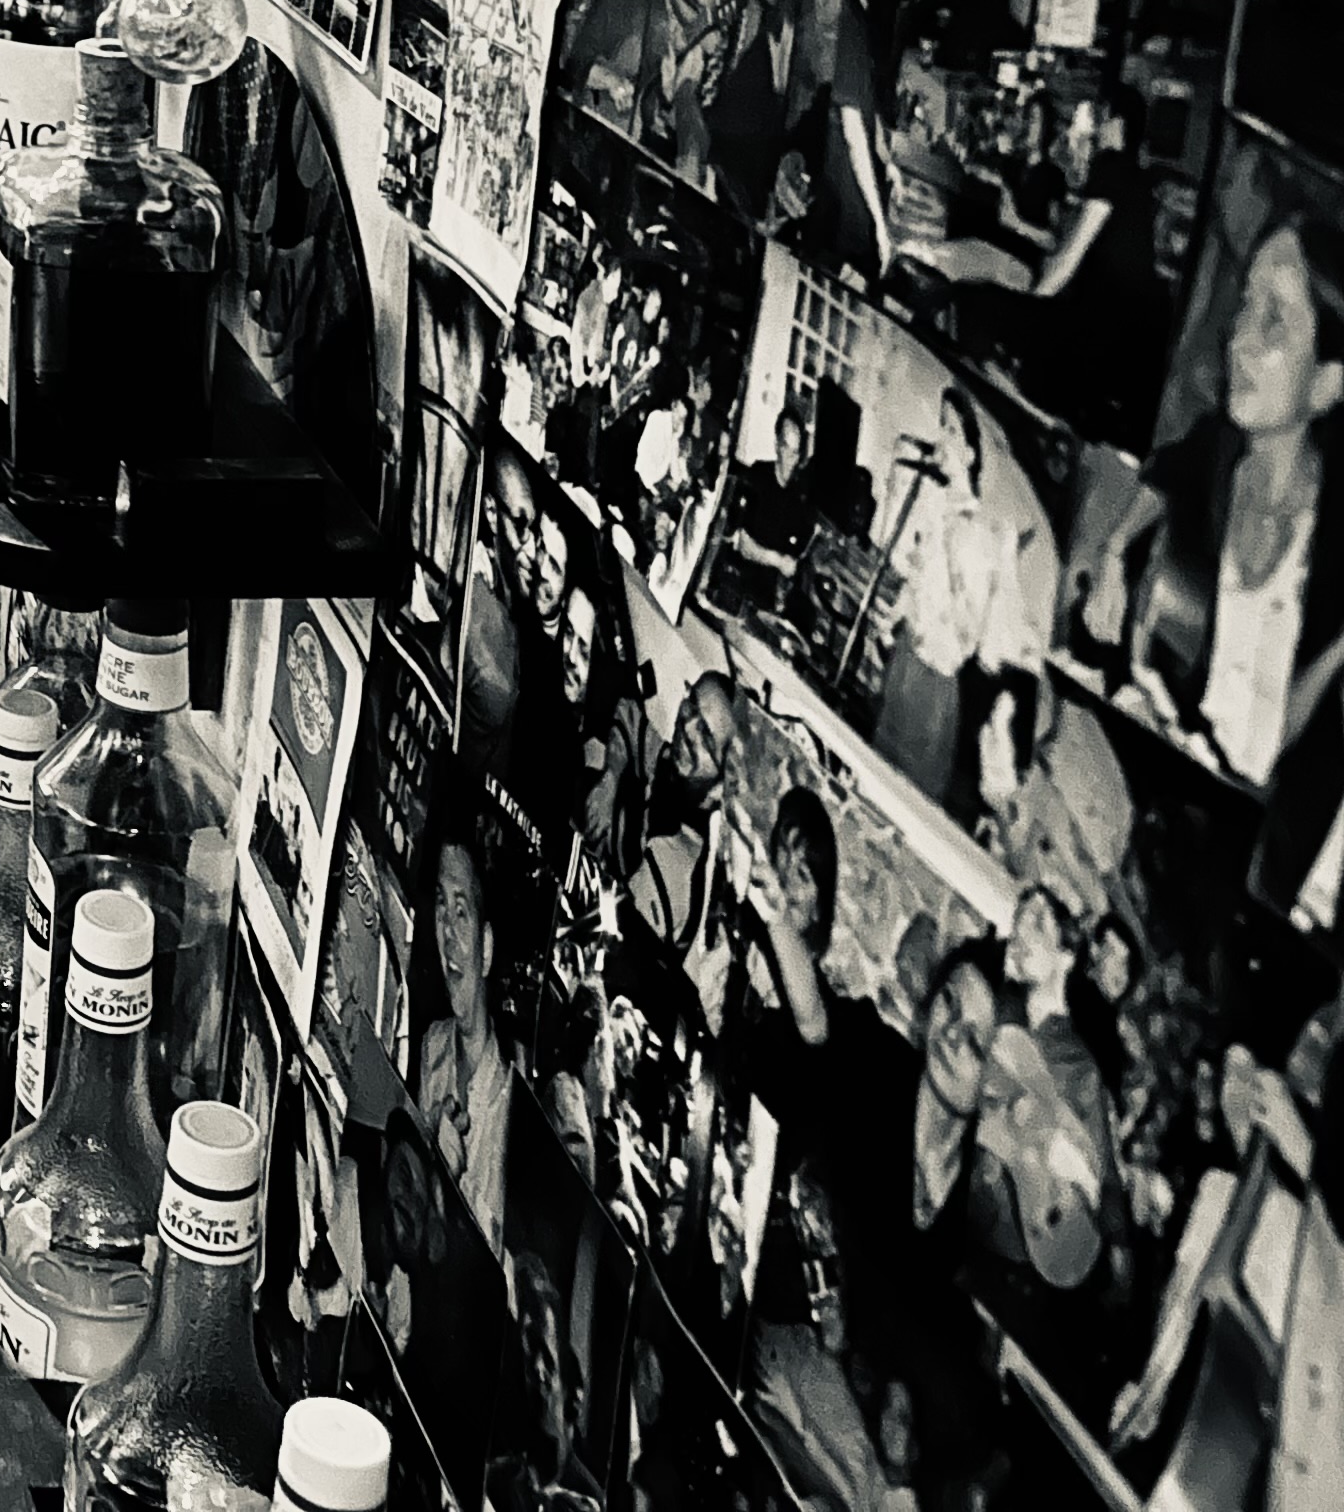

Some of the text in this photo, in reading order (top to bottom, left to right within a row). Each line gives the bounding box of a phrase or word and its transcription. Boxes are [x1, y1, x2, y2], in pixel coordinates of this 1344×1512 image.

[106, 679, 151, 702] SUGAR
[82, 995, 149, 1018] MONIN
[164, 1207, 239, 1246] MONIN
